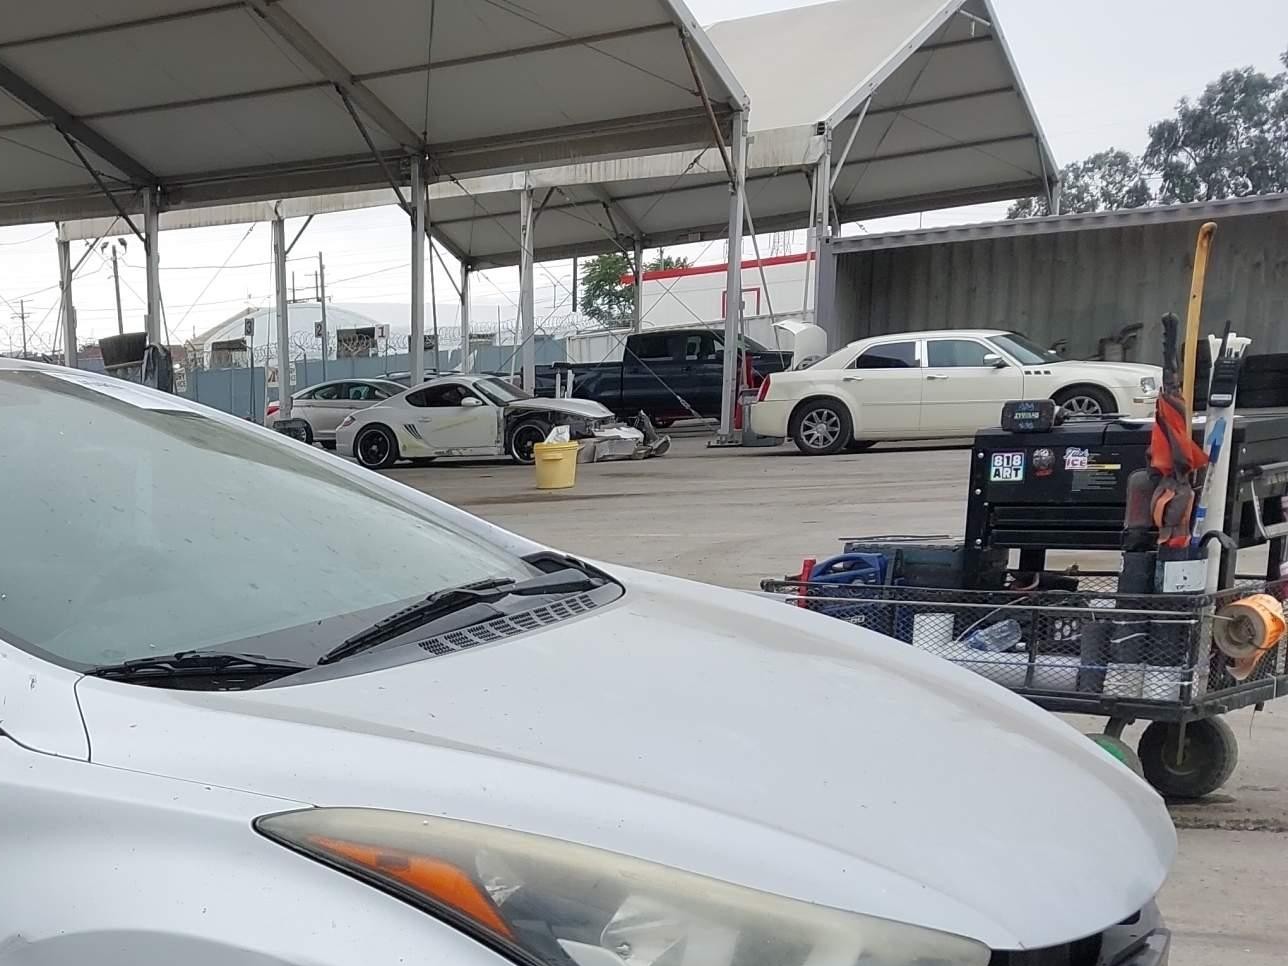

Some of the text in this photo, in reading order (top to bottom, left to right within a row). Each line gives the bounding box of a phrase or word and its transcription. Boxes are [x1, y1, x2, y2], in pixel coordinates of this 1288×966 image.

[246, 321, 252, 333] 3
[316, 324, 323, 336] 2
[378, 326, 385, 338] 1
[994, 455, 1022, 466] 818
[1067, 458, 1087, 467] ICE
[993, 468, 1021, 479] ART
